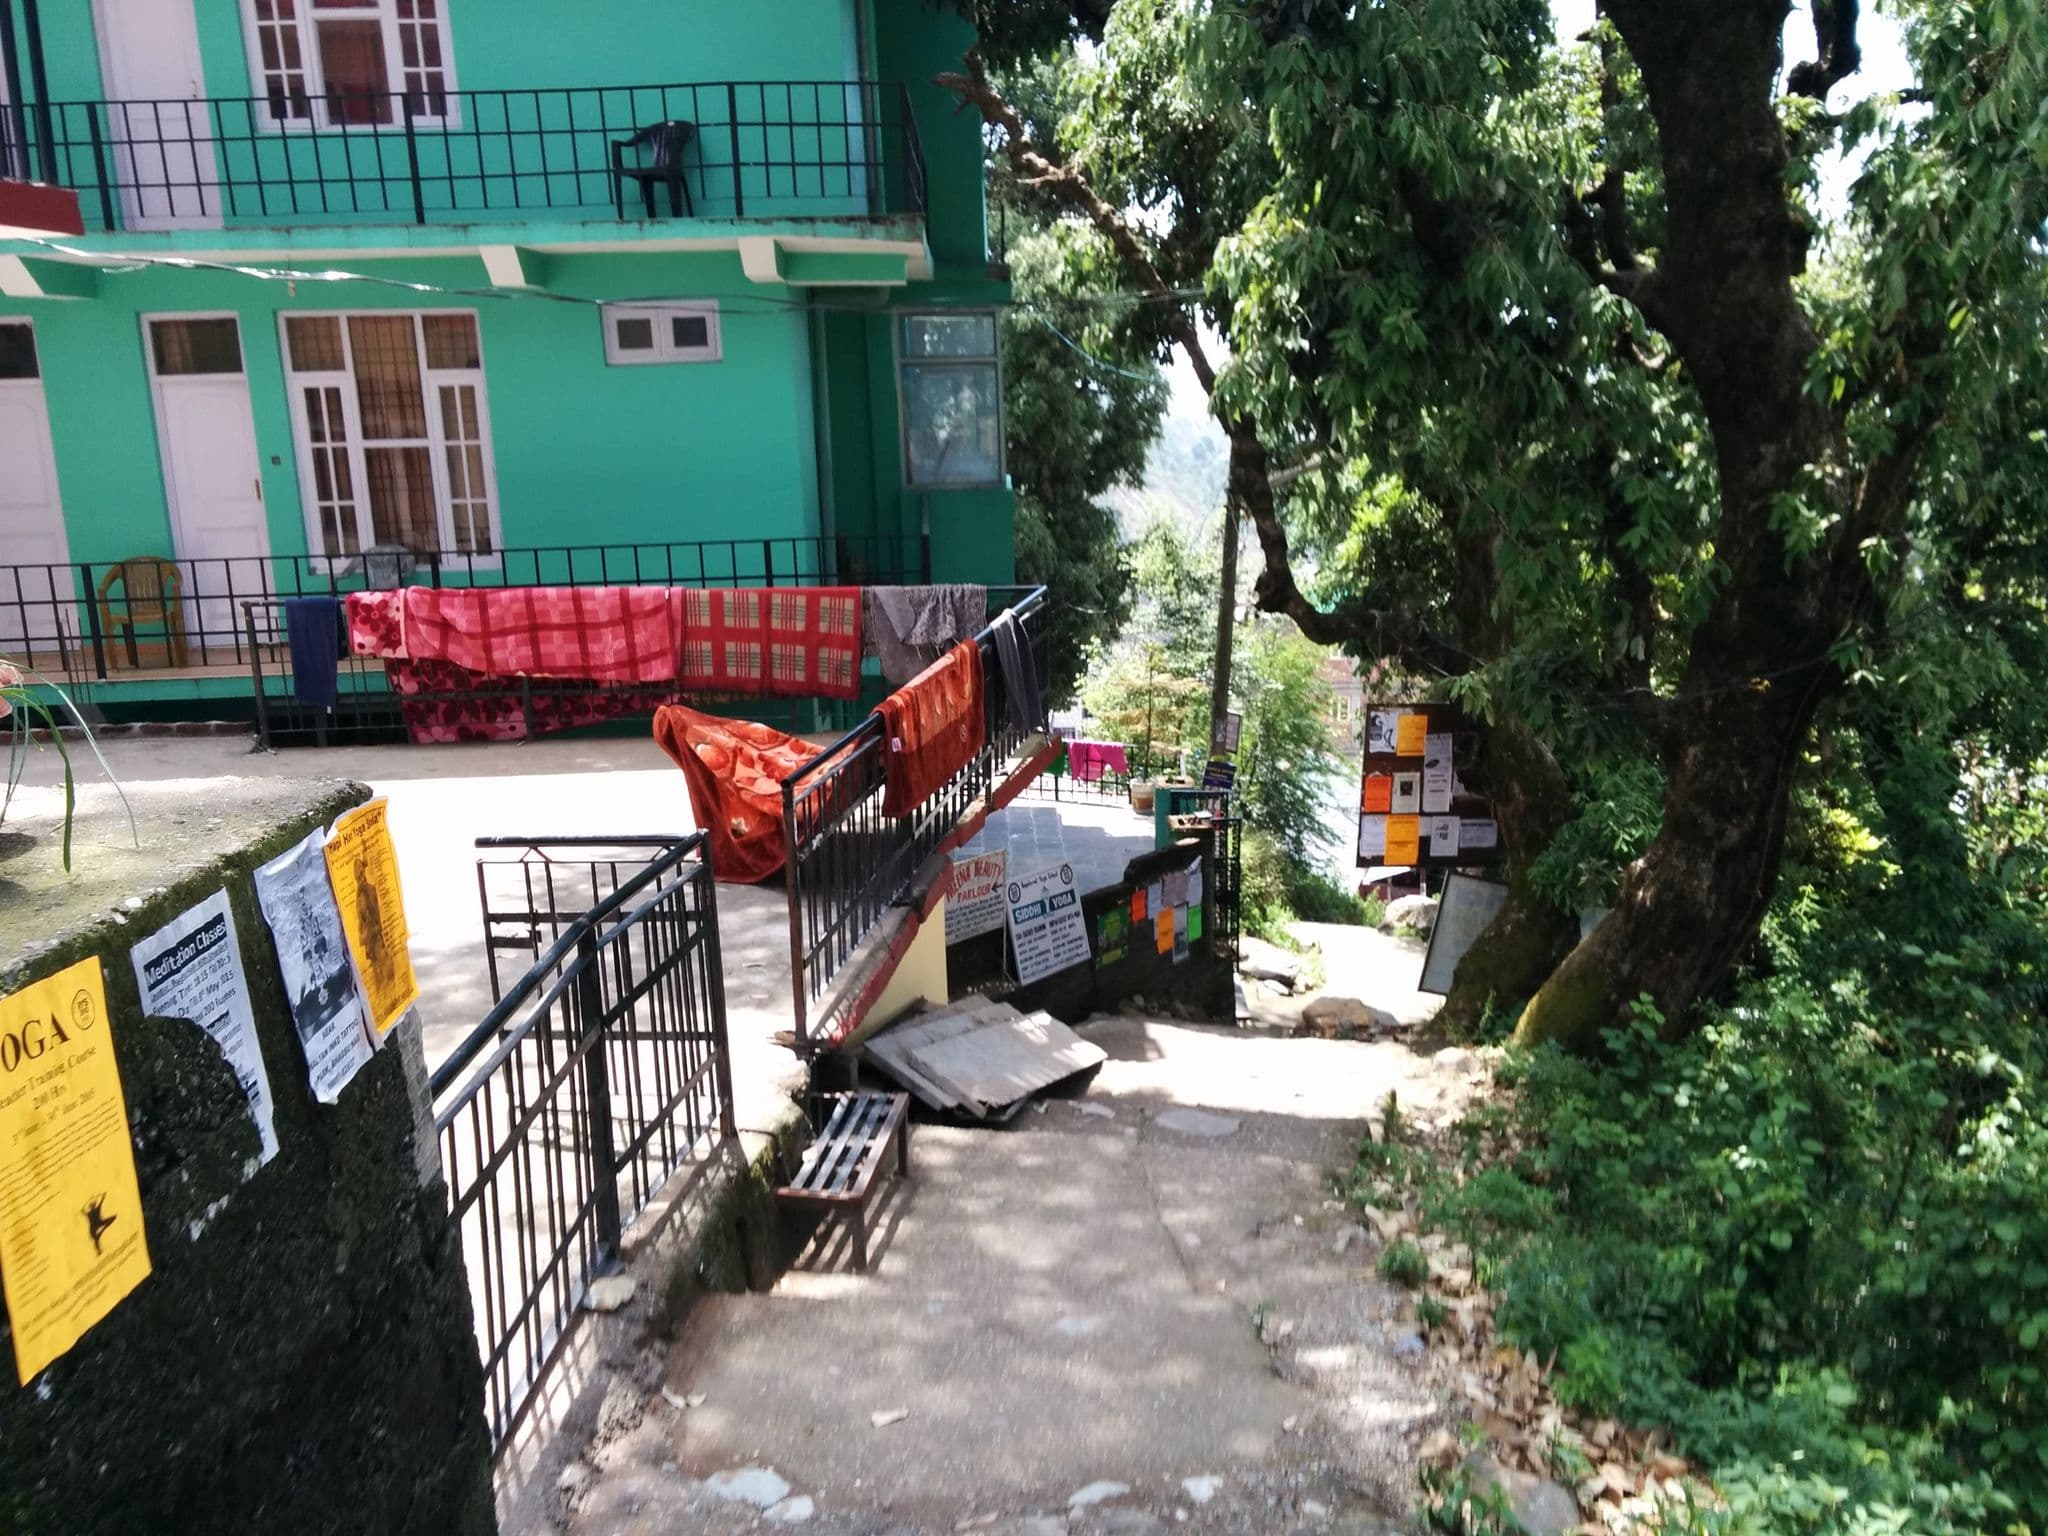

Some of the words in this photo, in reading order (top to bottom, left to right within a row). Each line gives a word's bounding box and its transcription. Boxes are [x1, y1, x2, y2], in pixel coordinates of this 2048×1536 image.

[1015, 903, 1042, 920] SIDDHI
[1051, 892, 1073, 909] YOGA
[145, 941, 197, 985] Meditation
